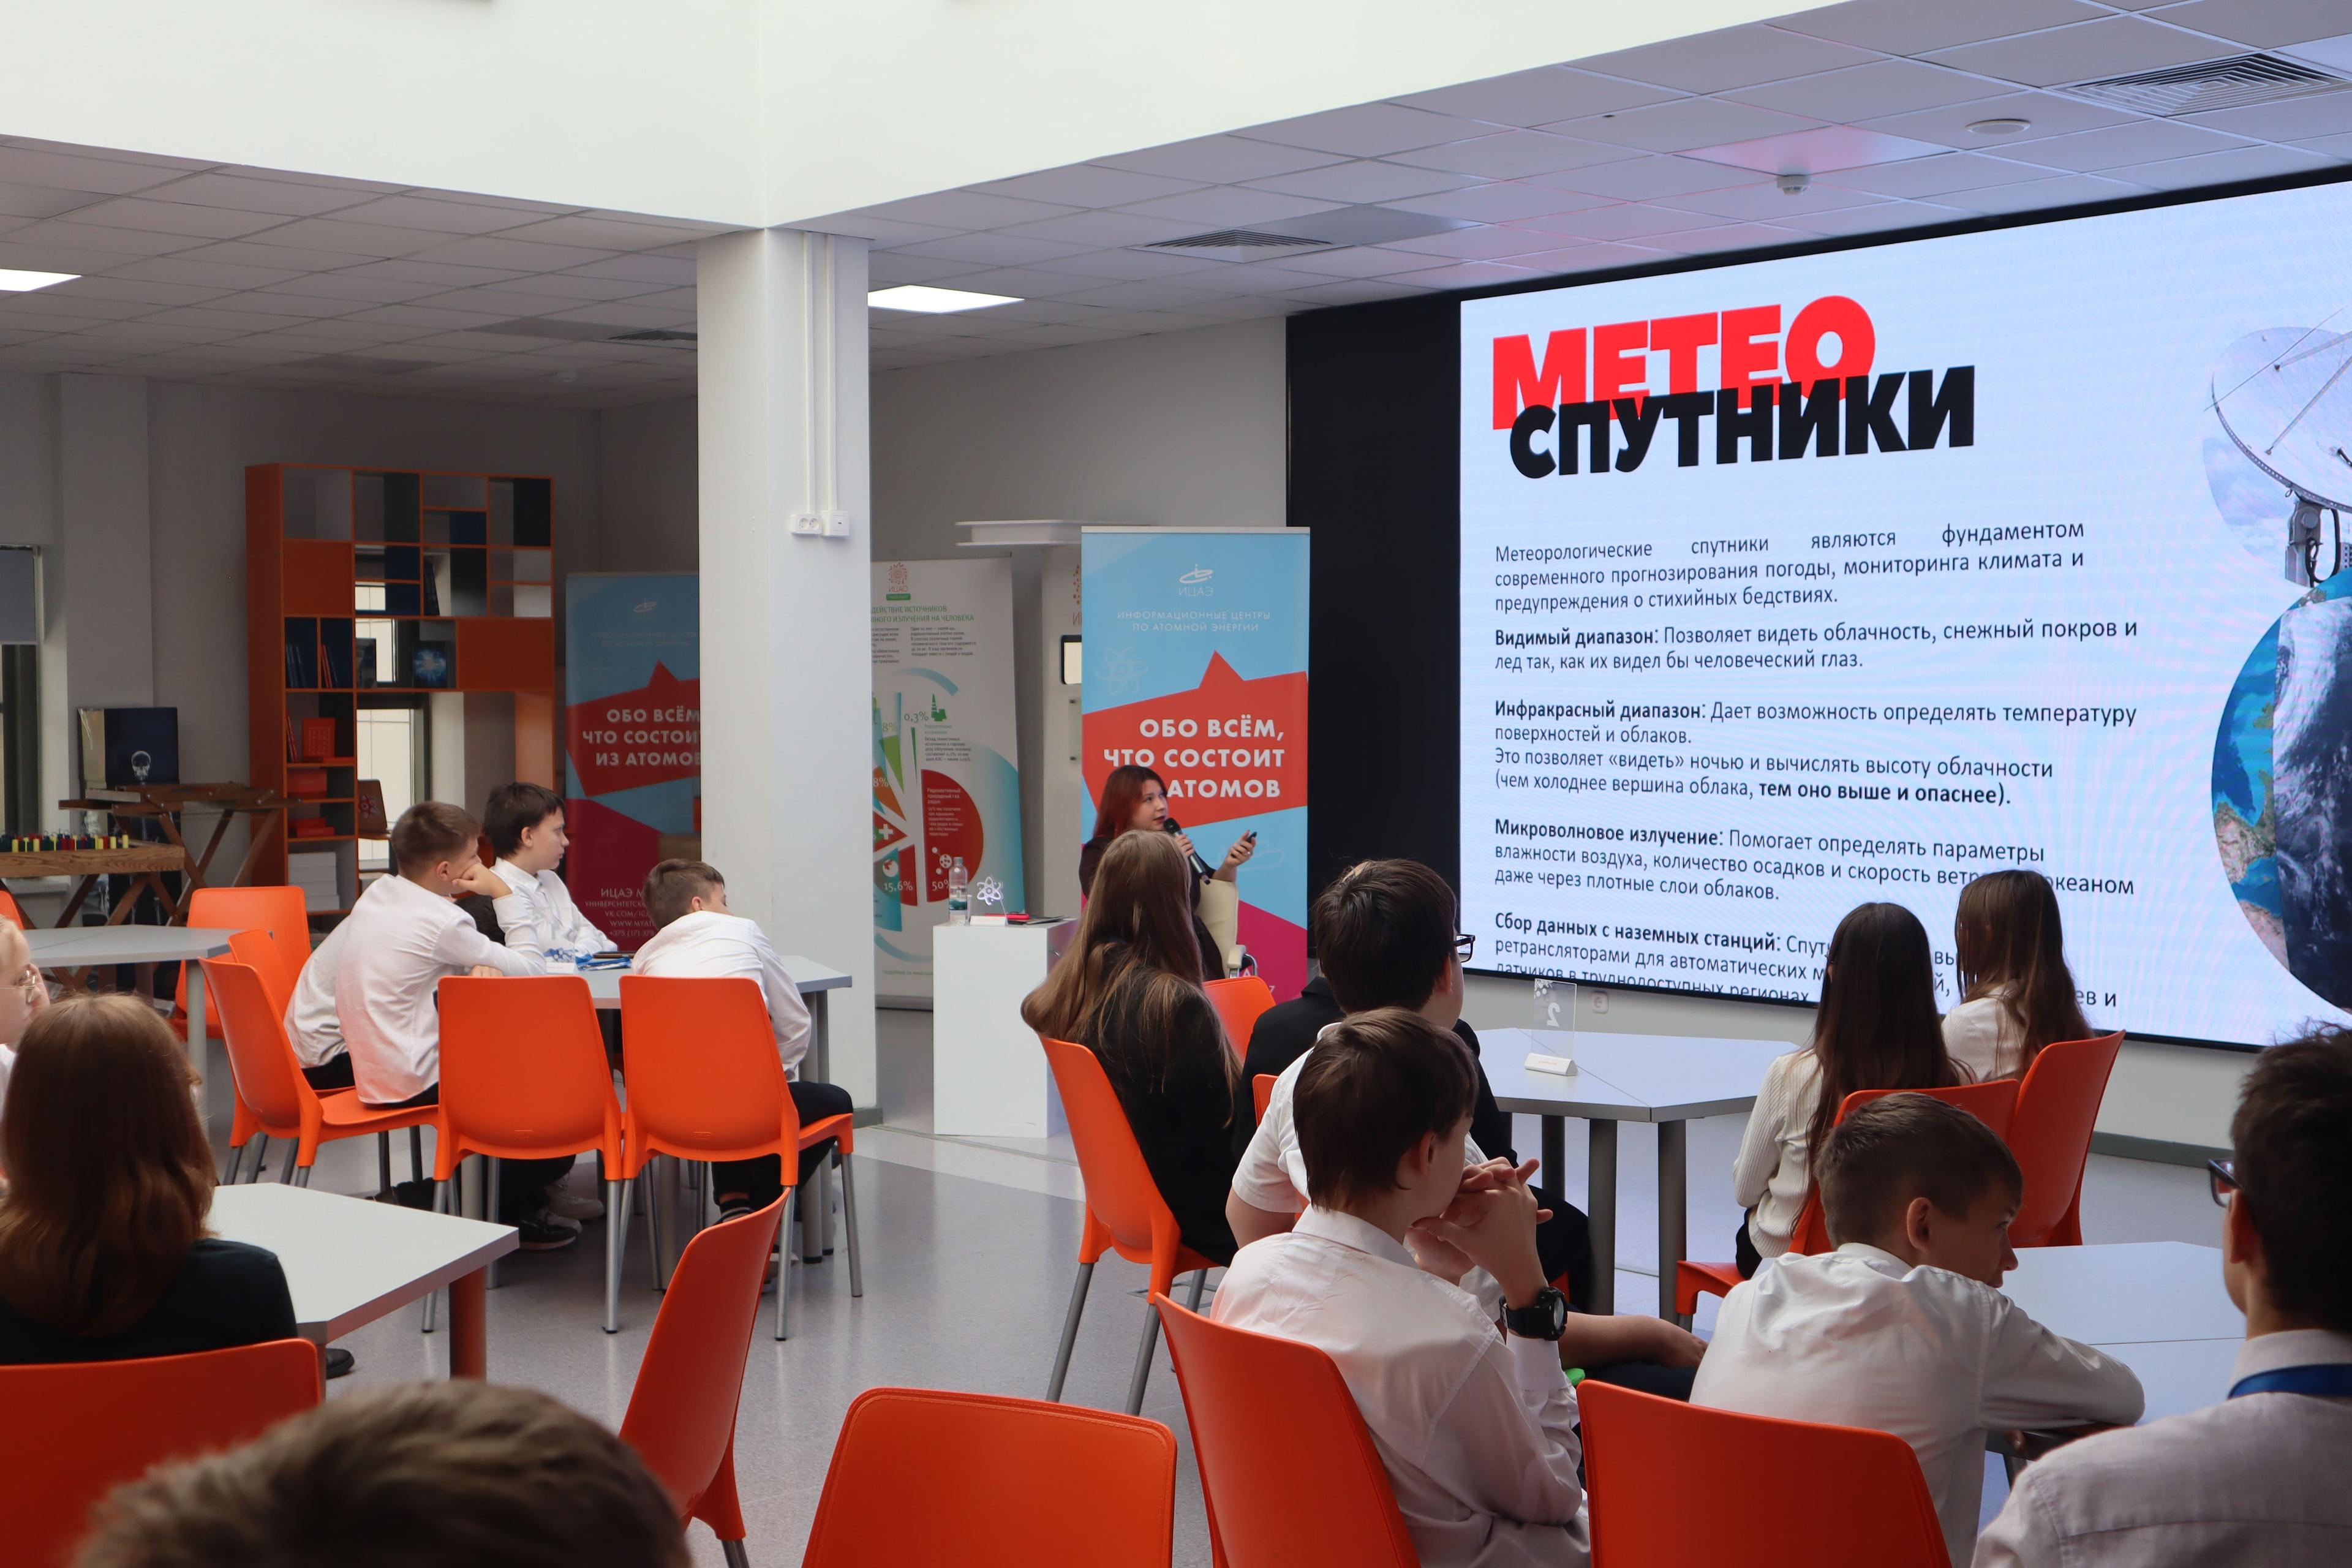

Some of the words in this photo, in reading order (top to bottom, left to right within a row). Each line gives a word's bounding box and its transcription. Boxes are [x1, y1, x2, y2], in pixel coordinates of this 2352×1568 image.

[1493, 295, 1875, 430] МЕТЕО
[1510, 365, 1975, 479] СПУТНИКИ
[1496, 544, 1652, 564] Метеорологические
[1692, 539, 1768, 557] спутники
[1812, 532, 1895, 549] являются
[1942, 523, 2083, 547] фундаментом
[1496, 571, 1604, 589] современного
[1612, 565, 1757, 586] прогнозирования
[1766, 563, 1835, 580] погоды,
[1844, 557, 1969, 576] мониторинга
[1979, 554, 2061, 570] климата
[2073, 552, 2082, 566] и
[1178, 586, 1213, 597] ИЦАЭ
[1496, 596, 1627, 614] предупреждения
[1634, 595, 1643, 607] о
[1649, 588, 1736, 607] стихийных
[1743, 586, 1837, 608] бедствиях.
[1117, 611, 1227, 620] ИНФОРМАЦИОННЫЕ
[1231, 611, 1271, 620] ЦЕНТРЫ
[1153, 622, 1207, 631] АТОМНОЙ
[1496, 627, 1570, 649] Видимый
[1575, 629, 1658, 649] диапазон:
[1665, 627, 1752, 643] Позволяет
[1758, 628, 1817, 646] видеть
[1825, 622, 1936, 644] облачность,
[1944, 619, 2033, 639] снежный
[2043, 622, 2117, 642] покров
[2125, 622, 2136, 636] и
[1495, 657, 1522, 673] лед
[1526, 657, 1554, 673] так,
[1561, 657, 1585, 668] как
[1591, 657, 1607, 668] их
[1614, 656, 1660, 673] видел
[1667, 650, 1688, 668] бы
[1695, 649, 1814, 668] человеческий
[1822, 654, 1862, 666] глаз.
[606, 709, 646, 723] ОБО
[653, 706, 700, 722] ВСЁМ
[904, 711, 929, 723] 0,3%
[1496, 699, 1615, 720] Инфракрасный
[1620, 704, 1705, 722] диапазон:
[1711, 702, 1751, 723] Дает
[1758, 706, 1877, 720] возможность
[1884, 707, 1996, 725] определять
[2003, 707, 2136, 727] температуру
[582, 731, 617, 744] ЧТО
[623, 730, 699, 744] СОСТОИ
[1139, 718, 1198, 738] ОБО
[1207, 714, 1284, 741] ВСЁМ,
[1496, 725, 1599, 744] поверхностей
[1607, 730, 1614, 742] и
[1621, 725, 1691, 743] облаков.
[595, 752, 619, 766] ИЗ
[1103, 748, 1155, 767] ЧТО
[1163, 748, 1285, 768] СОСТОИТ
[1496, 747, 1520, 763] Это
[1526, 753, 1603, 766] позволяет
[1609, 755, 1684, 771] «видеть»
[1691, 756, 1743, 769] ночью
[1751, 758, 1759, 770] и
[1767, 758, 1859, 772] вычислять
[1867, 760, 1931, 778] высоту
[1938, 755, 2052, 777] облачности
[1166, 779, 1281, 798] АТОМОВ
[1496, 769, 1528, 788] (чем
[1534, 777, 1607, 793] холоднее
[1613, 779, 1683, 795] вершина
[1690, 776, 1752, 800] облака,
[1759, 783, 1791, 796] тем
[1798, 785, 1831, 798] оно
[1838, 786, 1891, 800] выше
[1898, 787, 1908, 801] и
[1915, 782, 2010, 806] опаснее).
[1496, 819, 1624, 840] Микроволновое
[1630, 829, 1723, 847] излучение:
[1730, 829, 1812, 850] Помогает
[1819, 838, 1926, 858] определять
[1934, 843, 2043, 865] параметры
[1496, 846, 1575, 862] влажности
[1582, 851, 1647, 871] воздуха,
[1654, 856, 1747, 872] количество
[1754, 861, 1824, 880] осадков
[1832, 865, 1841, 877] и
[1849, 866, 1930, 884] скорость
[1937, 870, 1979, 884] ветр
[601, 888, 633, 899] ИЦАЭ
[883, 881, 913, 892] 15,6%
[1495, 870, 1533, 885] даже
[1539, 873, 1581, 889] через
[1588, 876, 1654, 891] плотные
[1660, 881, 1697, 894] слои
[1705, 878, 1779, 899] облаков.
[1496, 912, 1532, 934] Сбор
[1537, 921, 1597, 936] данных
[1602, 925, 1609, 937] с
[1616, 926, 1698, 944] наземных
[1705, 932, 1781, 953] станций:
[1787, 936, 1828, 958] Спут
[1496, 940, 1629, 964] ретрансляторами
[1635, 952, 1664, 969] для
[1670, 948, 1806, 979] автоматических
[2076, 990, 2096, 1005] ев
[2105, 993, 2116, 1007] и
[1497, 963, 1562, 979] датчиков
